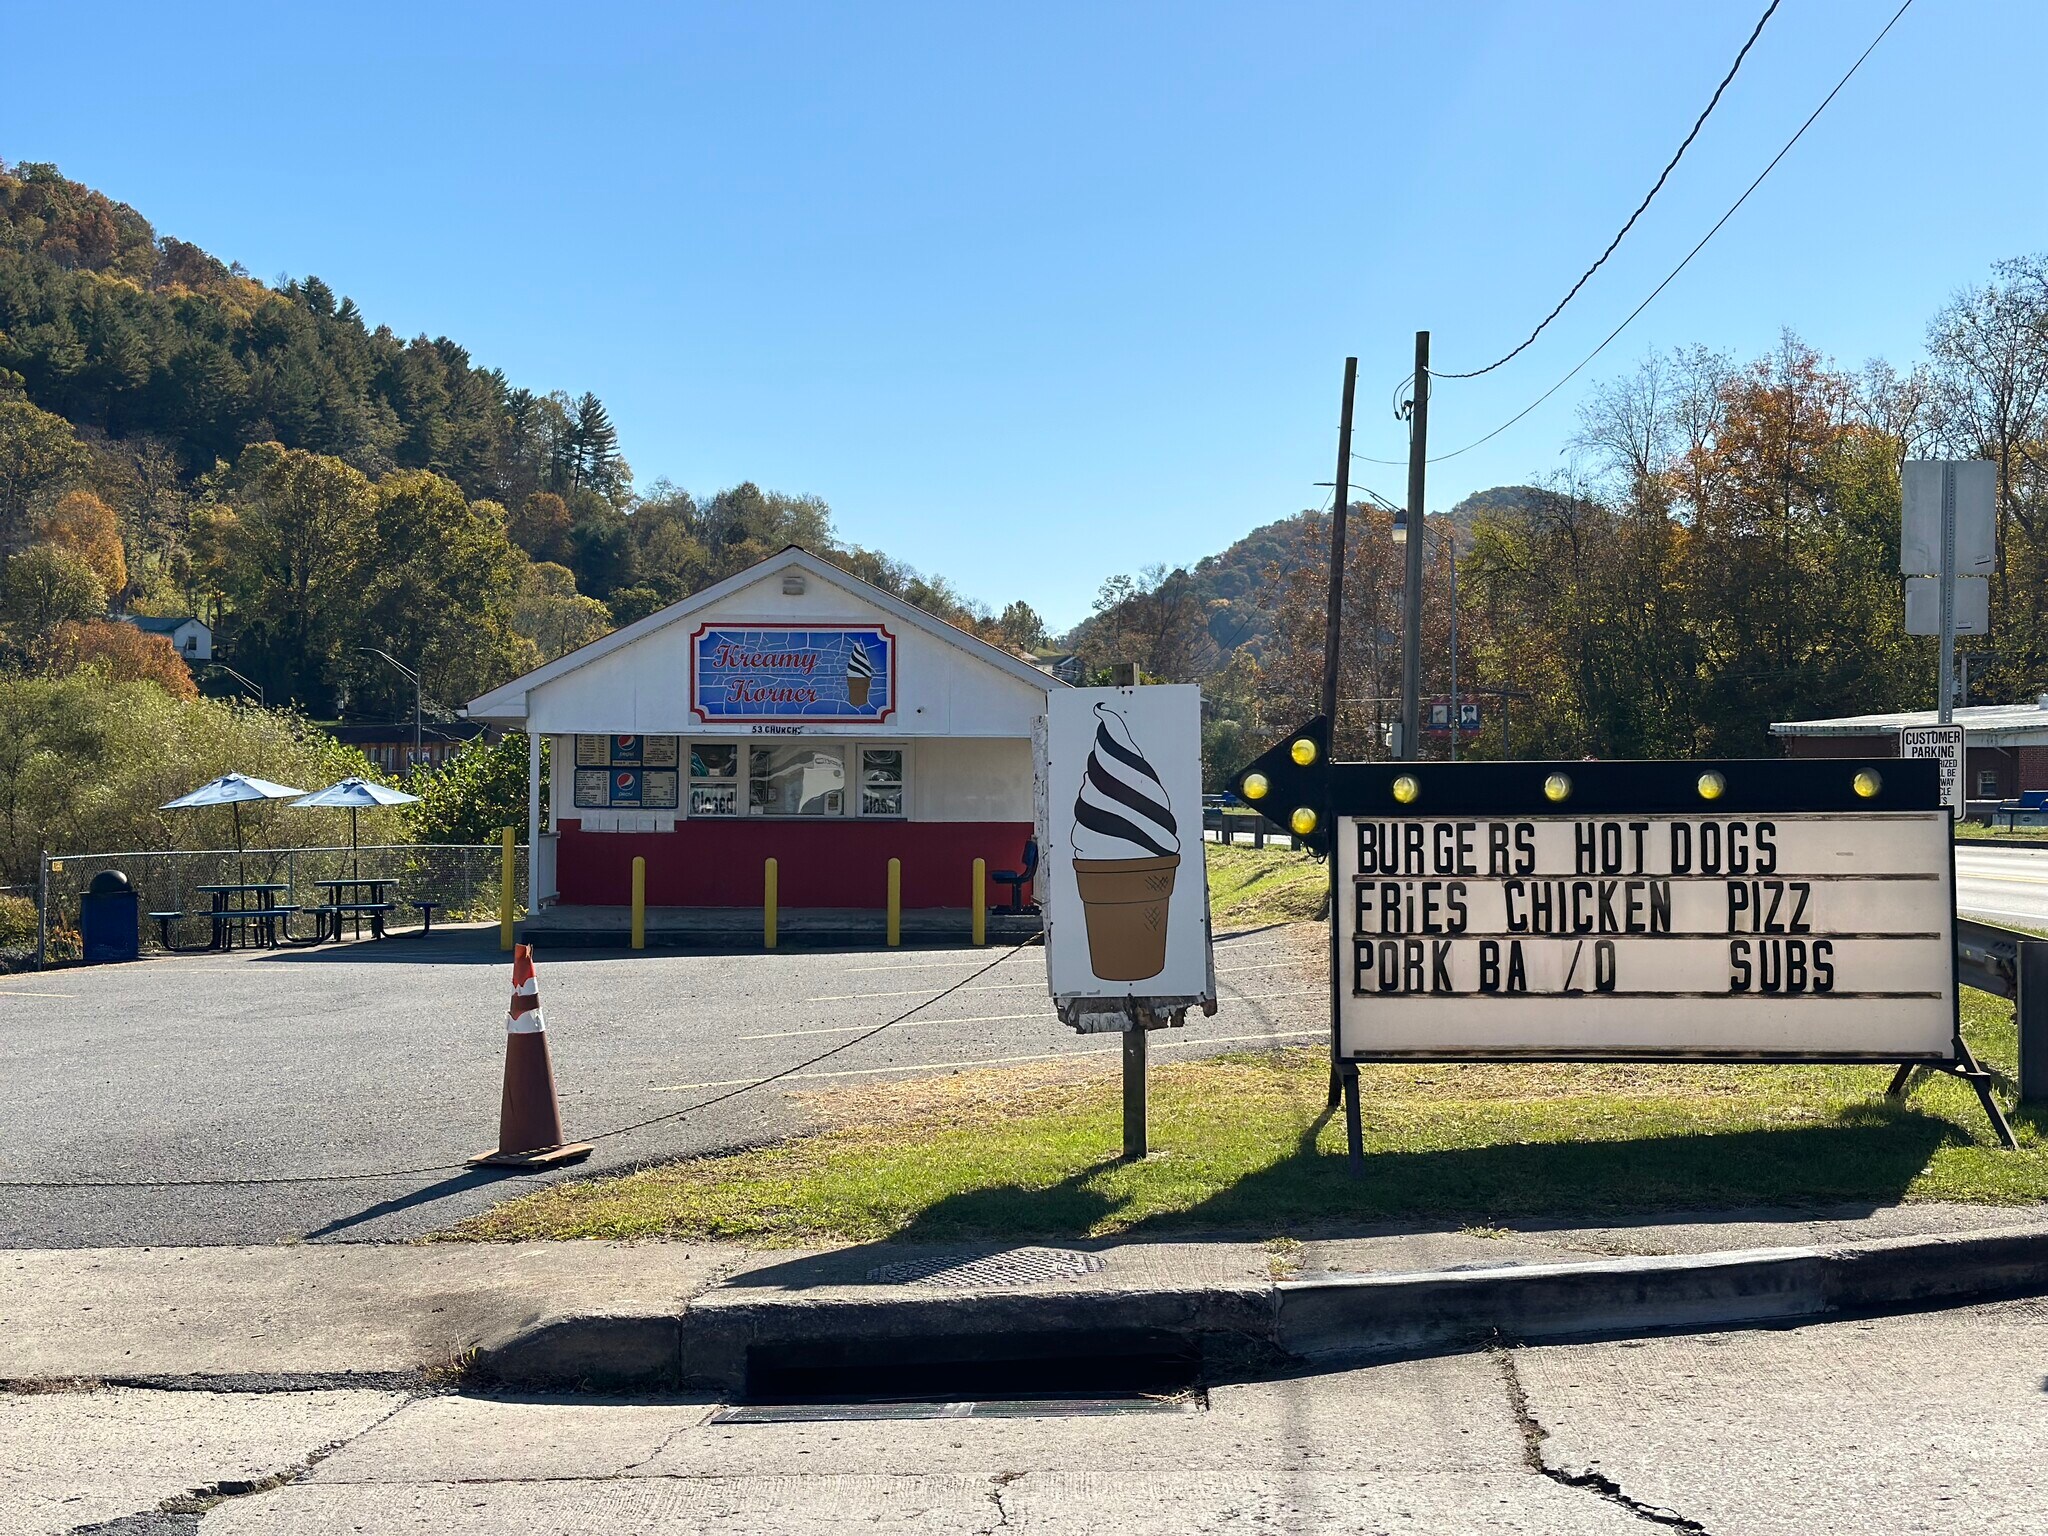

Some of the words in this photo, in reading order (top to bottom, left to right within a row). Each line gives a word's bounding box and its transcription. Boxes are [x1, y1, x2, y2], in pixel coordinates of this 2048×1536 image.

[713, 644, 817, 675] Kreamy
[727, 680, 818, 703] Korner
[752, 725, 763, 734] 53
[1905, 731, 1961, 745] CUSTOMER
[1911, 745, 1955, 758] PARKING
[1357, 822, 1535, 874] BURGERS
[1575, 822, 1649, 874] HOT
[1671, 822, 1776, 874] DOGS
[1504, 881, 1671, 933] CHICKEN
[1728, 881, 1811, 933] PIZZ
[1354, 940, 1453, 992] PORK
[1479, 940, 1527, 992] BA
[1730, 940, 1834, 992] SUBS
